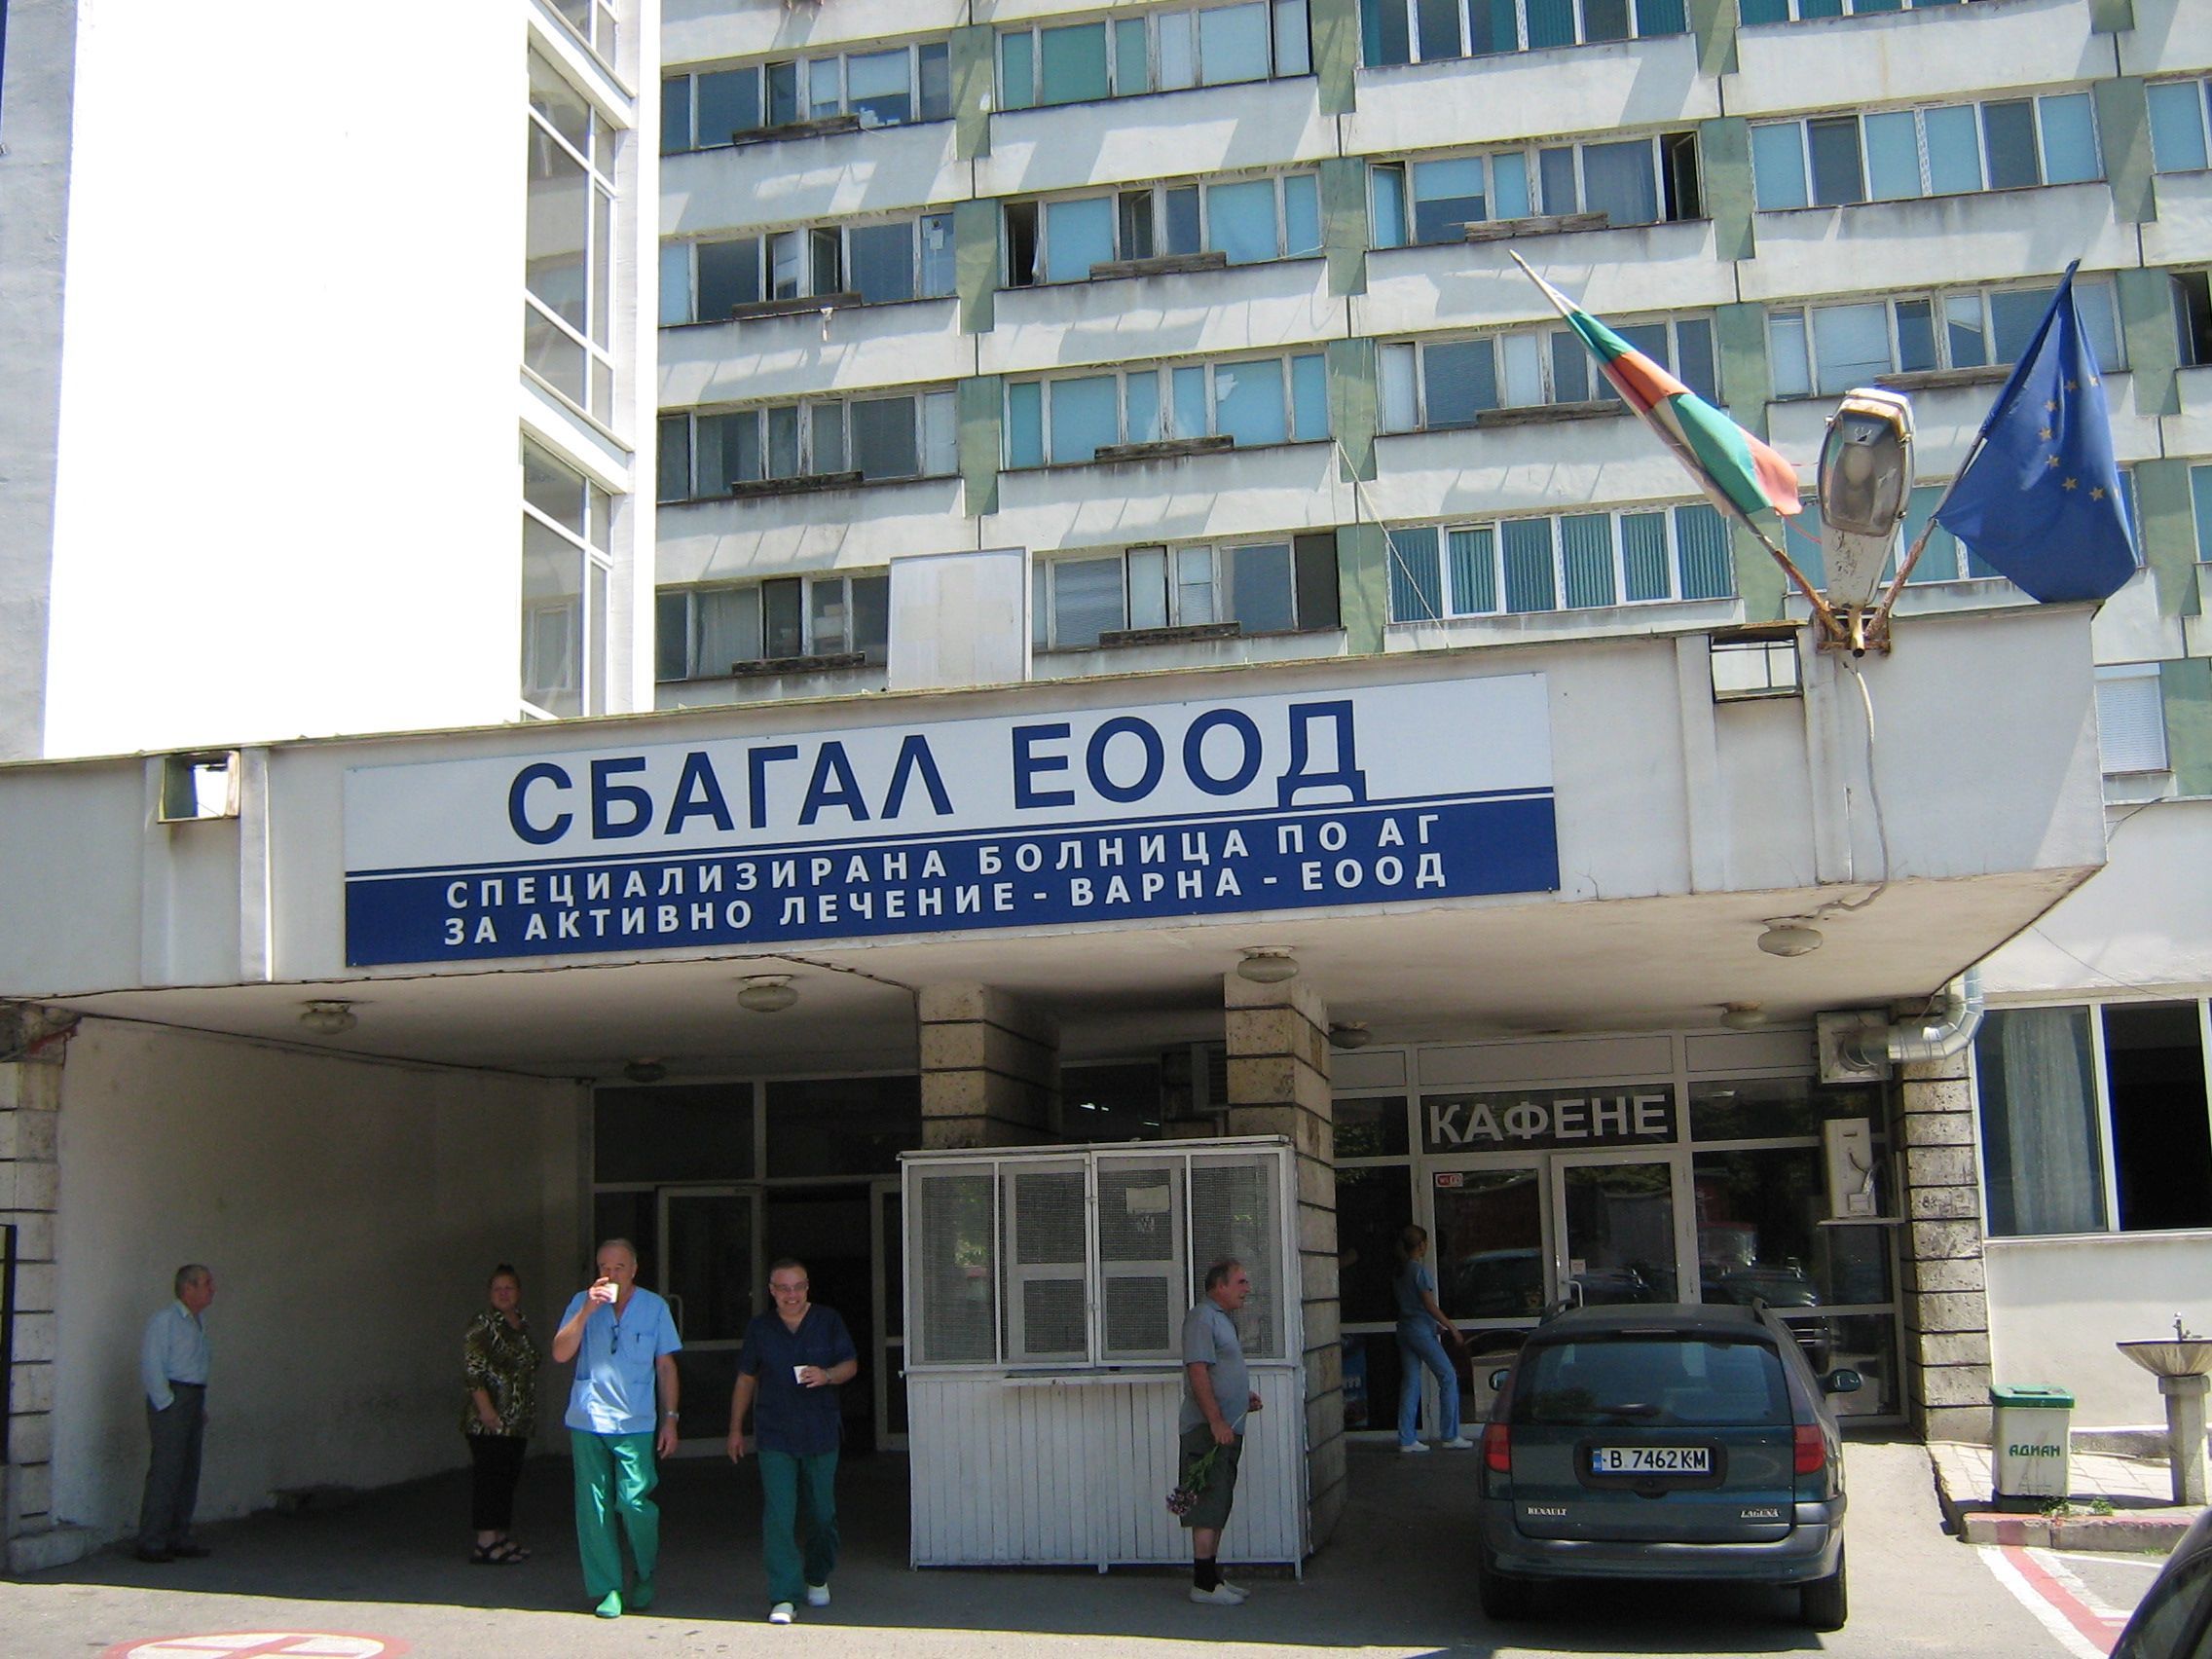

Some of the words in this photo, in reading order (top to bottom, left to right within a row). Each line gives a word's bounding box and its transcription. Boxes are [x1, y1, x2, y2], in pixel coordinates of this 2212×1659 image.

[508, 734, 954, 845] СБАГАЛ
[1012, 699, 1367, 810] ЕООД
[444, 916, 498, 946] ЗА
[524, 900, 752, 940] АКТИВНО
[779, 882, 1015, 926] ЛЕЧЕНИЕ
[1071, 867, 1241, 907] ВАРНА
[1303, 852, 1446, 891] ЕООД
[446, 850, 946, 909] СПЕЦИАЛИЗИРАНА
[978, 829, 1248, 875] БОЛНИЦА
[1277, 821, 1347, 854] ПО
[1378, 814, 1440, 846] АГ
[1429, 1094, 1668, 1144] КАФЕНЕ
[1527, 1506, 1567, 1517] RENAULT
